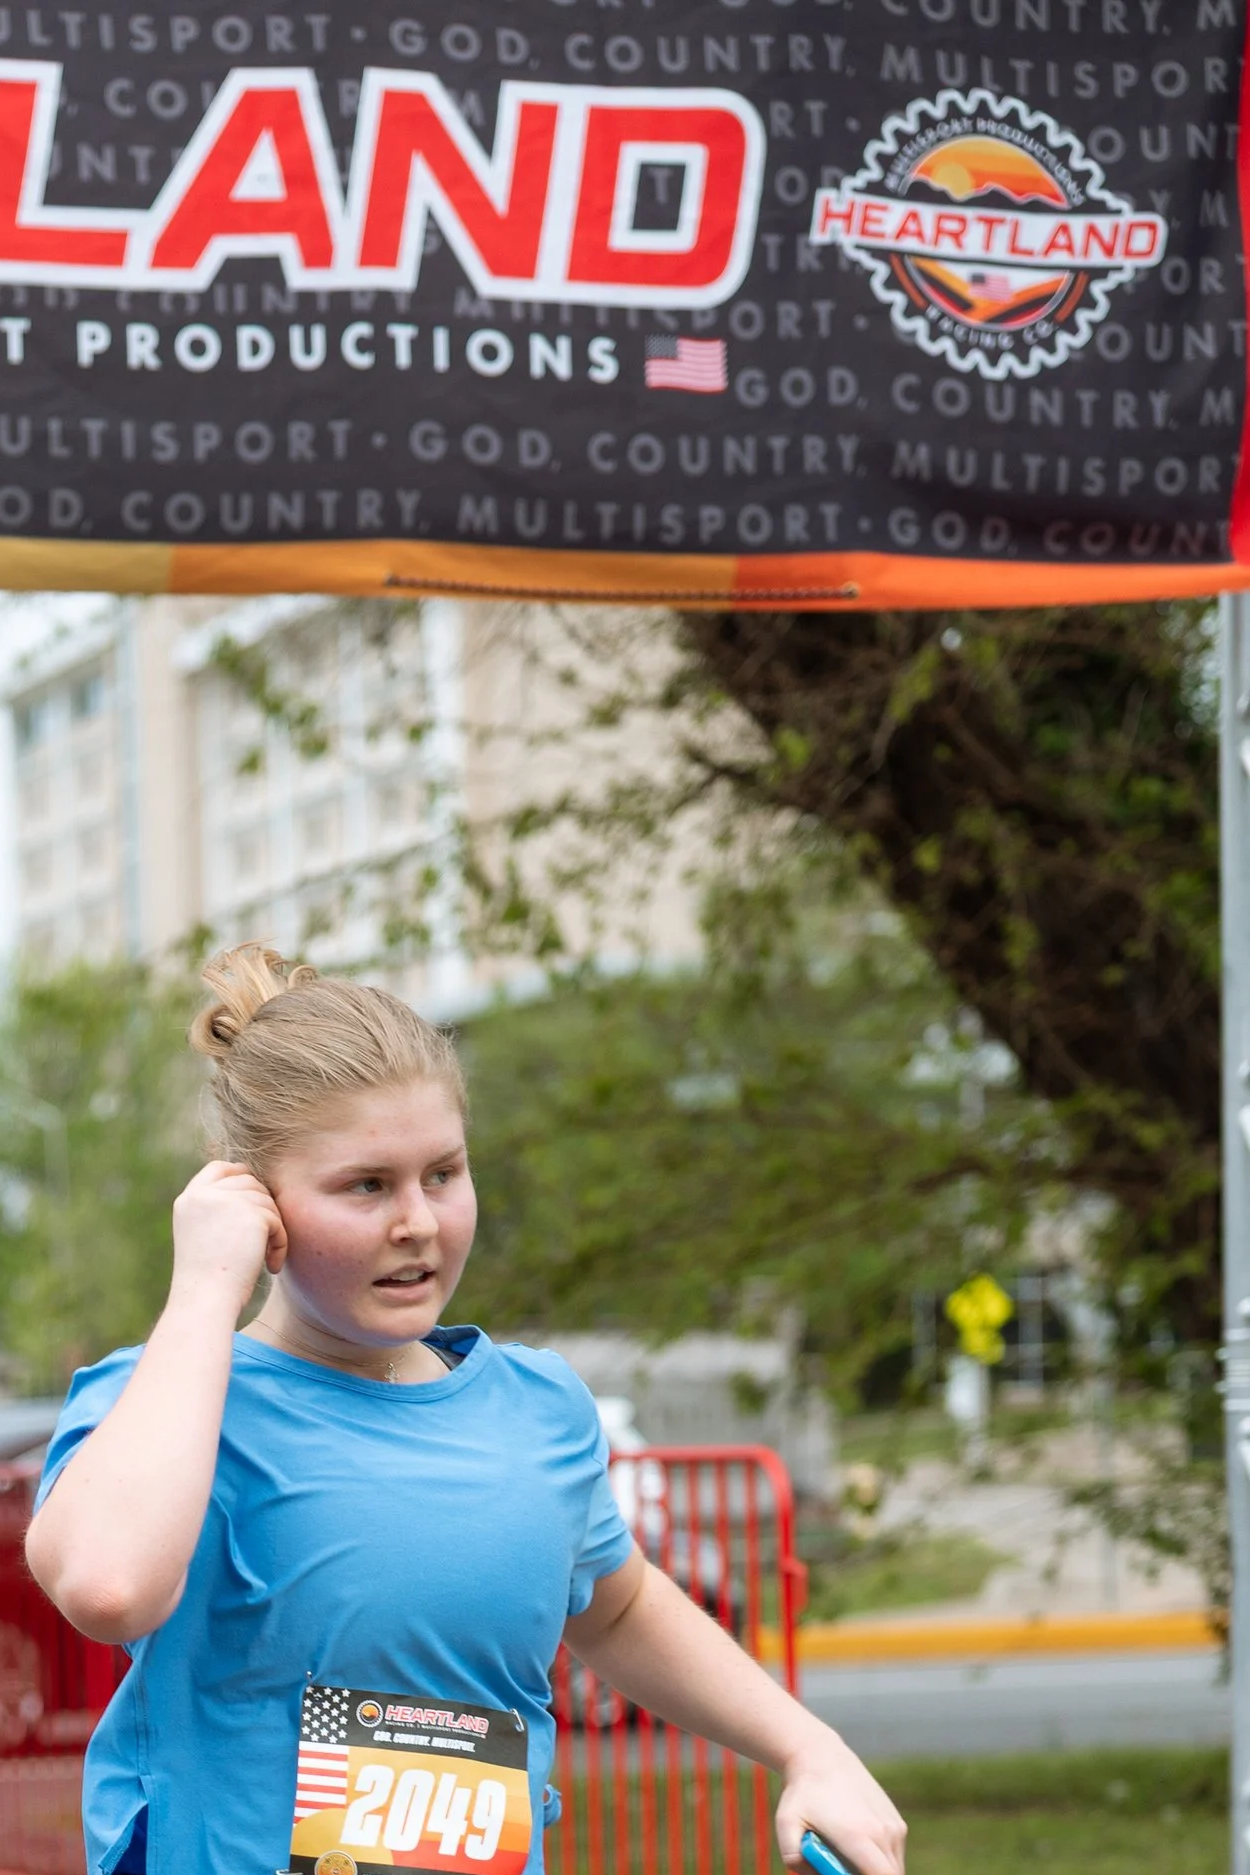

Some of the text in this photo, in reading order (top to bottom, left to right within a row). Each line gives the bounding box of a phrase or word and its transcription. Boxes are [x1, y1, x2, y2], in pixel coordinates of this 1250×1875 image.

[388, 19, 541, 70] GOD,
[565, 33, 855, 74] COUNTRY,
[880, 45, 1244, 100] MULTISPOR
[814, 196, 1160, 264] HEARTLAND
[75, 318, 620, 384] PRODUCTIONS
[735, 370, 867, 410] GOD,
[891, 372, 1180, 431] COUNTRY,
[408, 419, 562, 474] GOD,
[587, 431, 868, 479] COUNTRY,
[890, 442, 1241, 497] MULTISPOR
[120, 489, 430, 534] COUNTRY,
[456, 495, 842, 545] MULTISPORT
[384, 1704, 490, 1734] HEARTLAND
[339, 1764, 507, 1861] 2049
